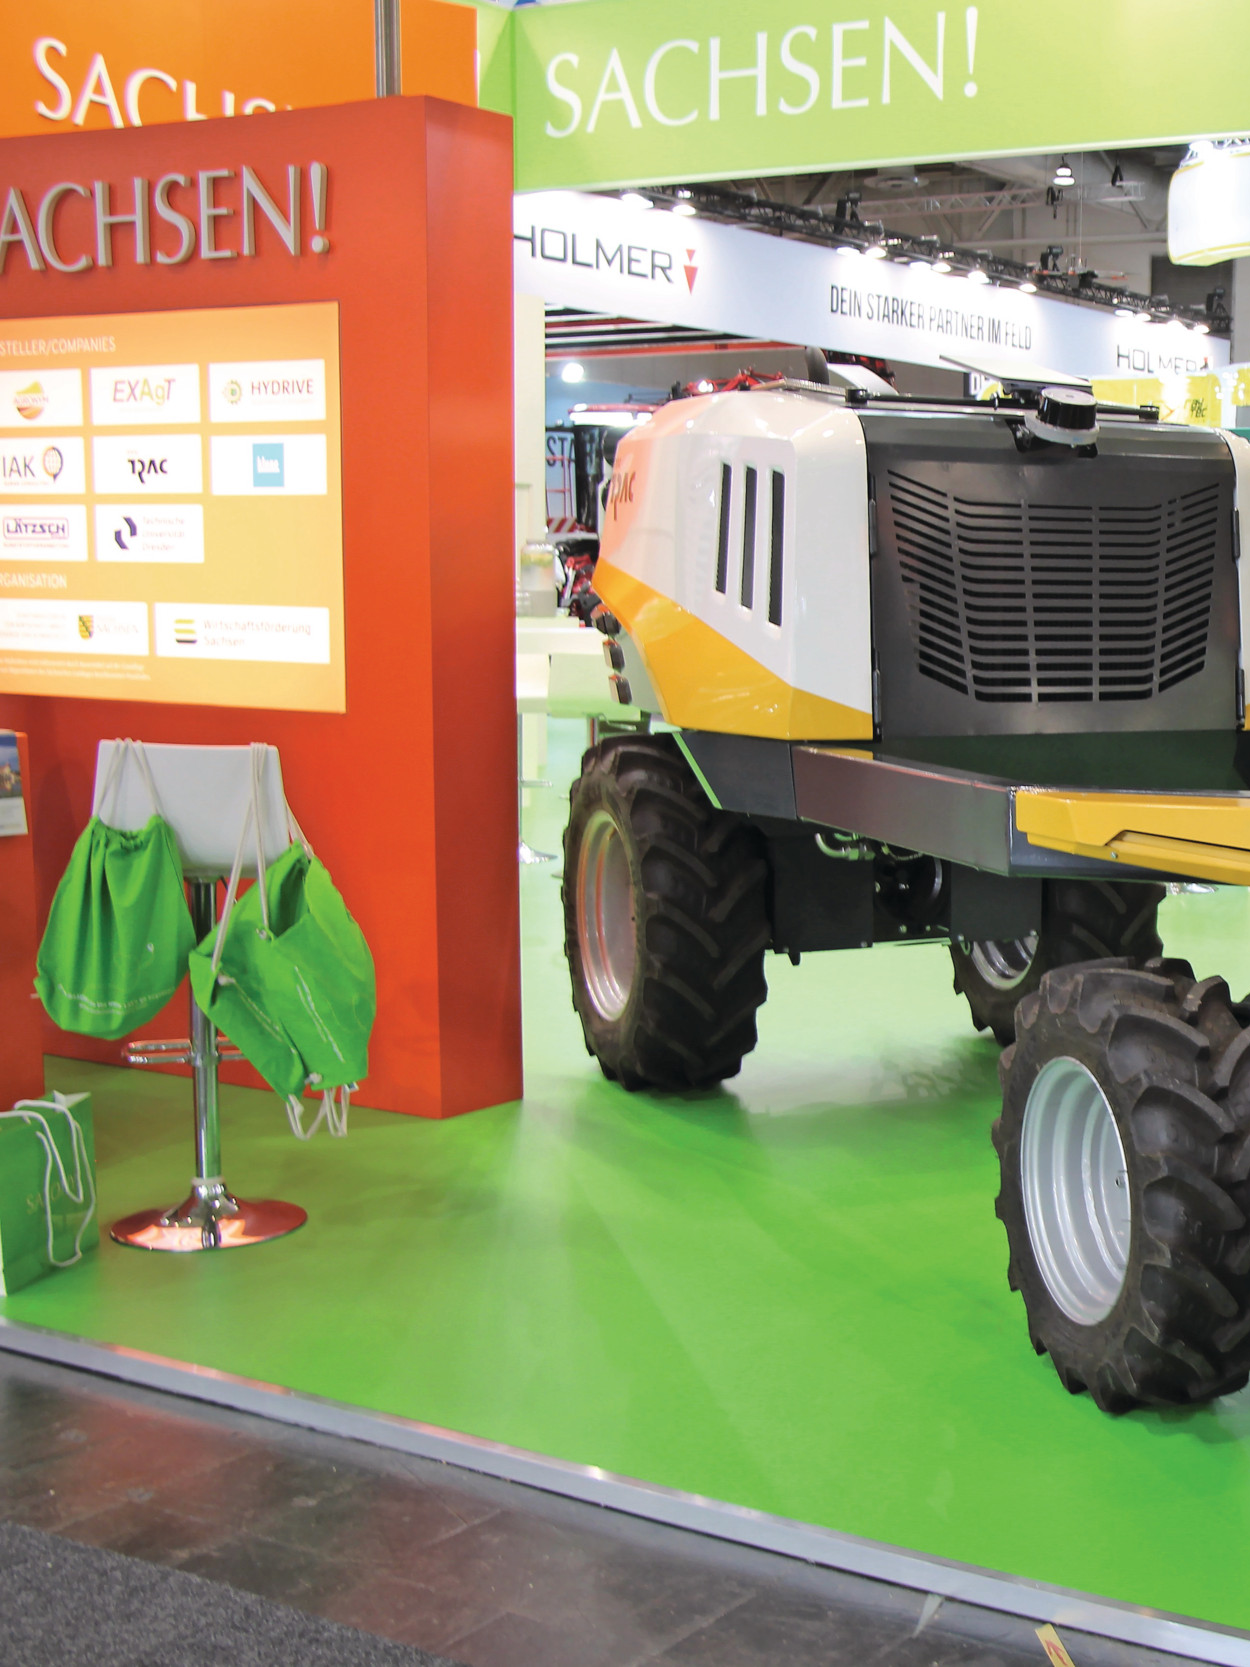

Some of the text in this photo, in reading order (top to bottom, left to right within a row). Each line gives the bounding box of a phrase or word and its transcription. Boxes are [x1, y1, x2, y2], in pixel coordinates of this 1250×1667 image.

[545, 6, 979, 139] SACHSEN!
[0, 161, 330, 277] ACHSEN!
[514, 224, 674, 284] HOLMER
[830, 284, 1032, 351] DEIN STARKER PARTNER IM FELD
[251, 379, 314, 396] HYDRIVE
